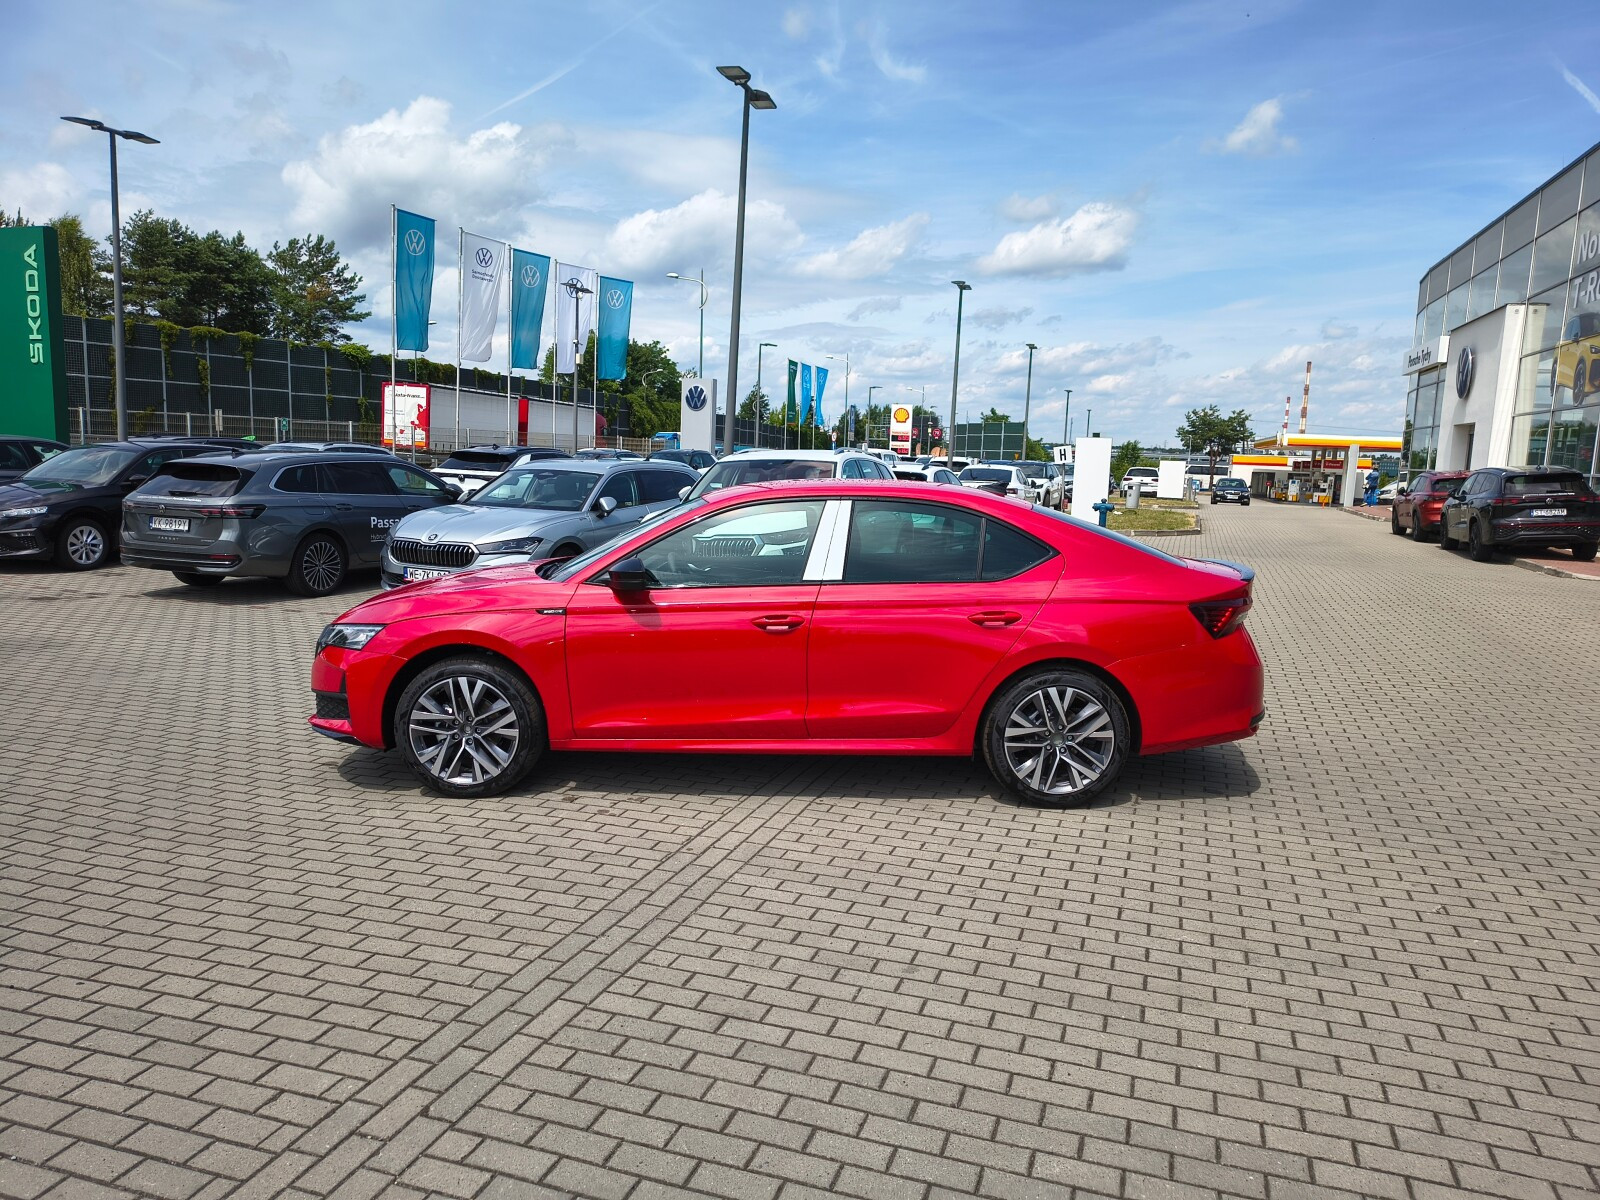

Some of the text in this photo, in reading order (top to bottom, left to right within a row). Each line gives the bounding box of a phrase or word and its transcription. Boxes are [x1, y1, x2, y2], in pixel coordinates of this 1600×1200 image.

[1577, 230, 1600, 264] No
[1060, 448, 1066, 461] H
[153, 517, 187, 530] KK 9819Y
[370, 516, 400, 528] Pass
[408, 568, 419, 579] WE
